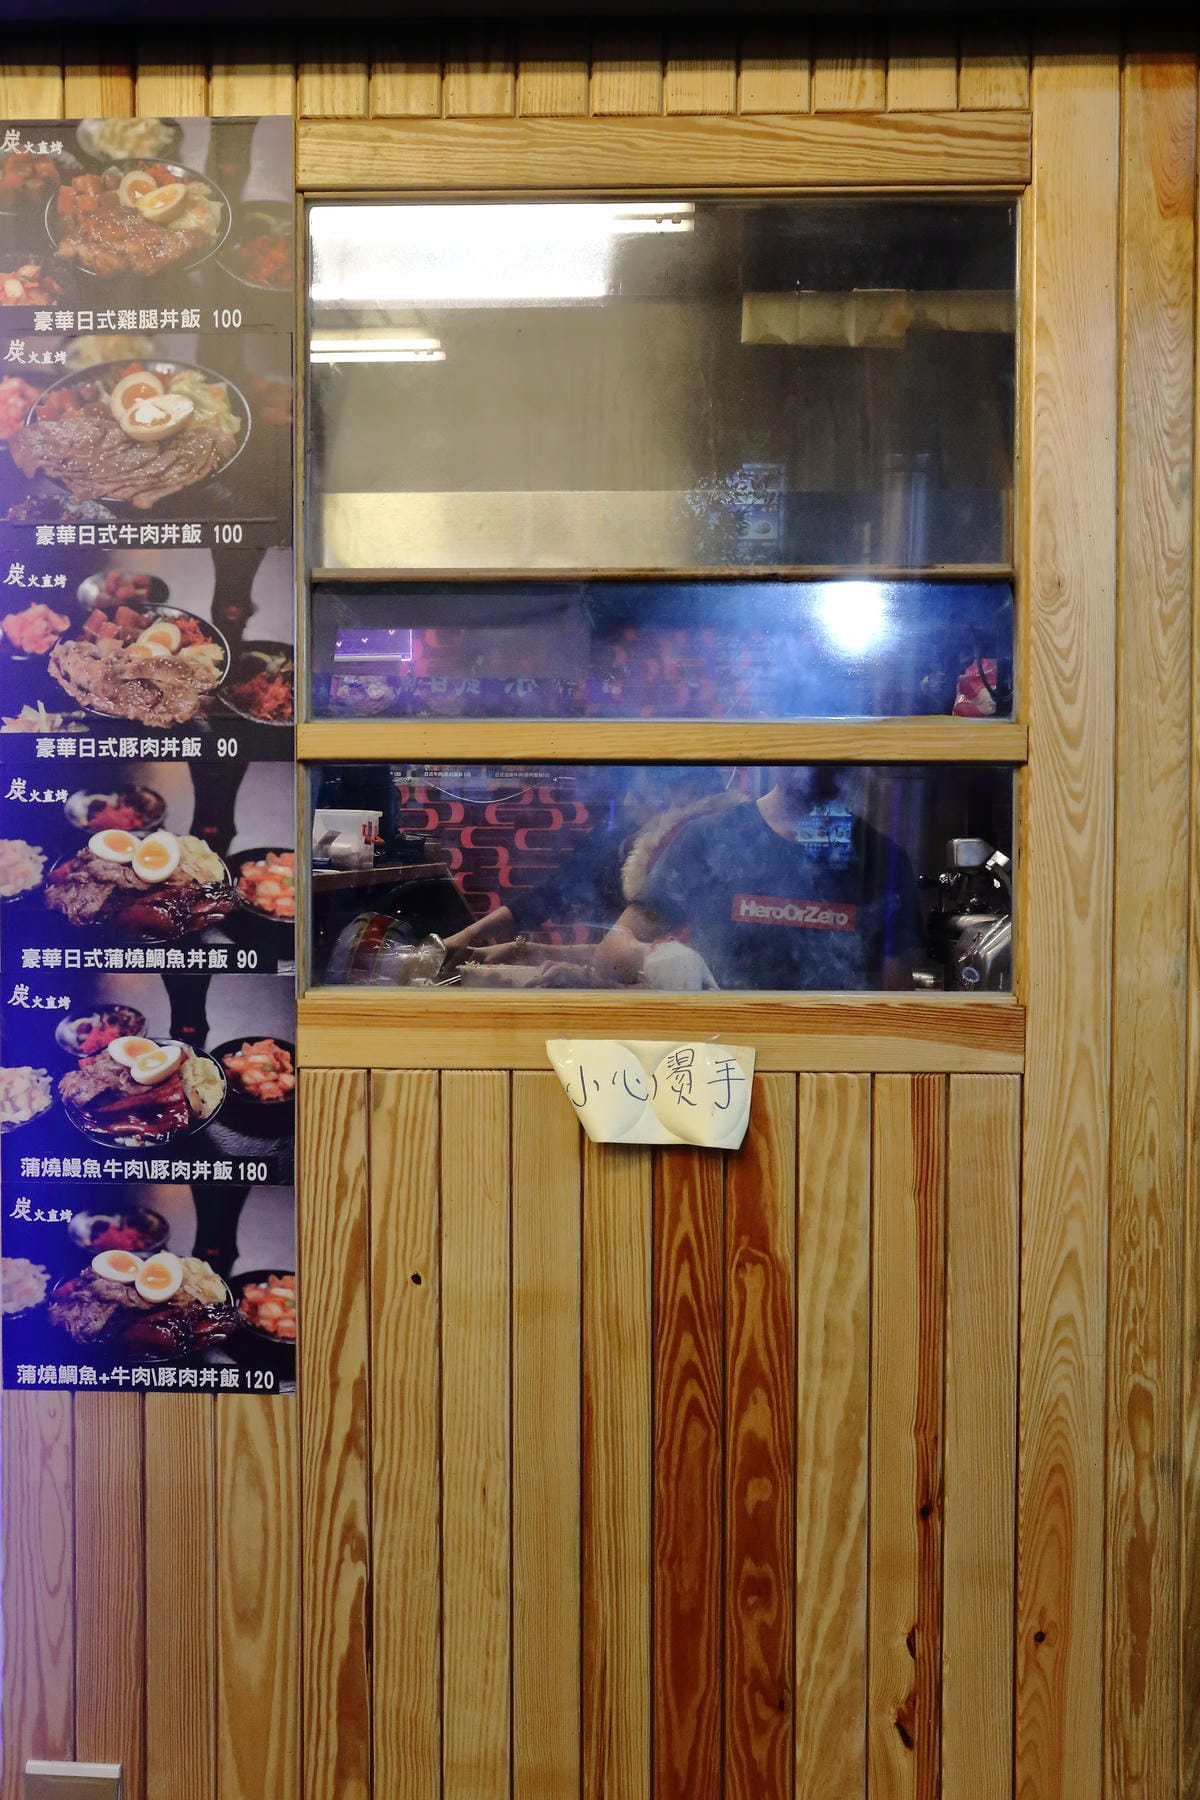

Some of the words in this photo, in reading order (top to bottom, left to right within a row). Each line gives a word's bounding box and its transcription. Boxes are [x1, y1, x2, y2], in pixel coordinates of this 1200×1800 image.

[0, 129, 64, 155] 炭火直烤
[34, 309, 201, 332] 豪華日式雞腿丼飯
[213, 309, 242, 328] 100
[3, 339, 68, 365] 炭火直烤
[35, 524, 202, 546] 豪華日式牛肉丼飯
[213, 525, 243, 544] 100
[3, 562, 68, 588] 炭火直烤
[35, 737, 202, 759] 豪華日式豚肉丼飯
[217, 738, 238, 758] 90
[5, 777, 69, 803] 炭火直烤
[738, 899, 849, 926] HeroOrZero
[21, 948, 228, 969] 豪華日式蒲燒鯛魚丼飯
[237, 949, 258, 969] 90
[7, 983, 71, 1010] 炭火直烤
[239, 1162, 268, 1182] 180
[9, 1196, 73, 1223] 炭火直烤
[245, 1370, 274, 1390] 120
